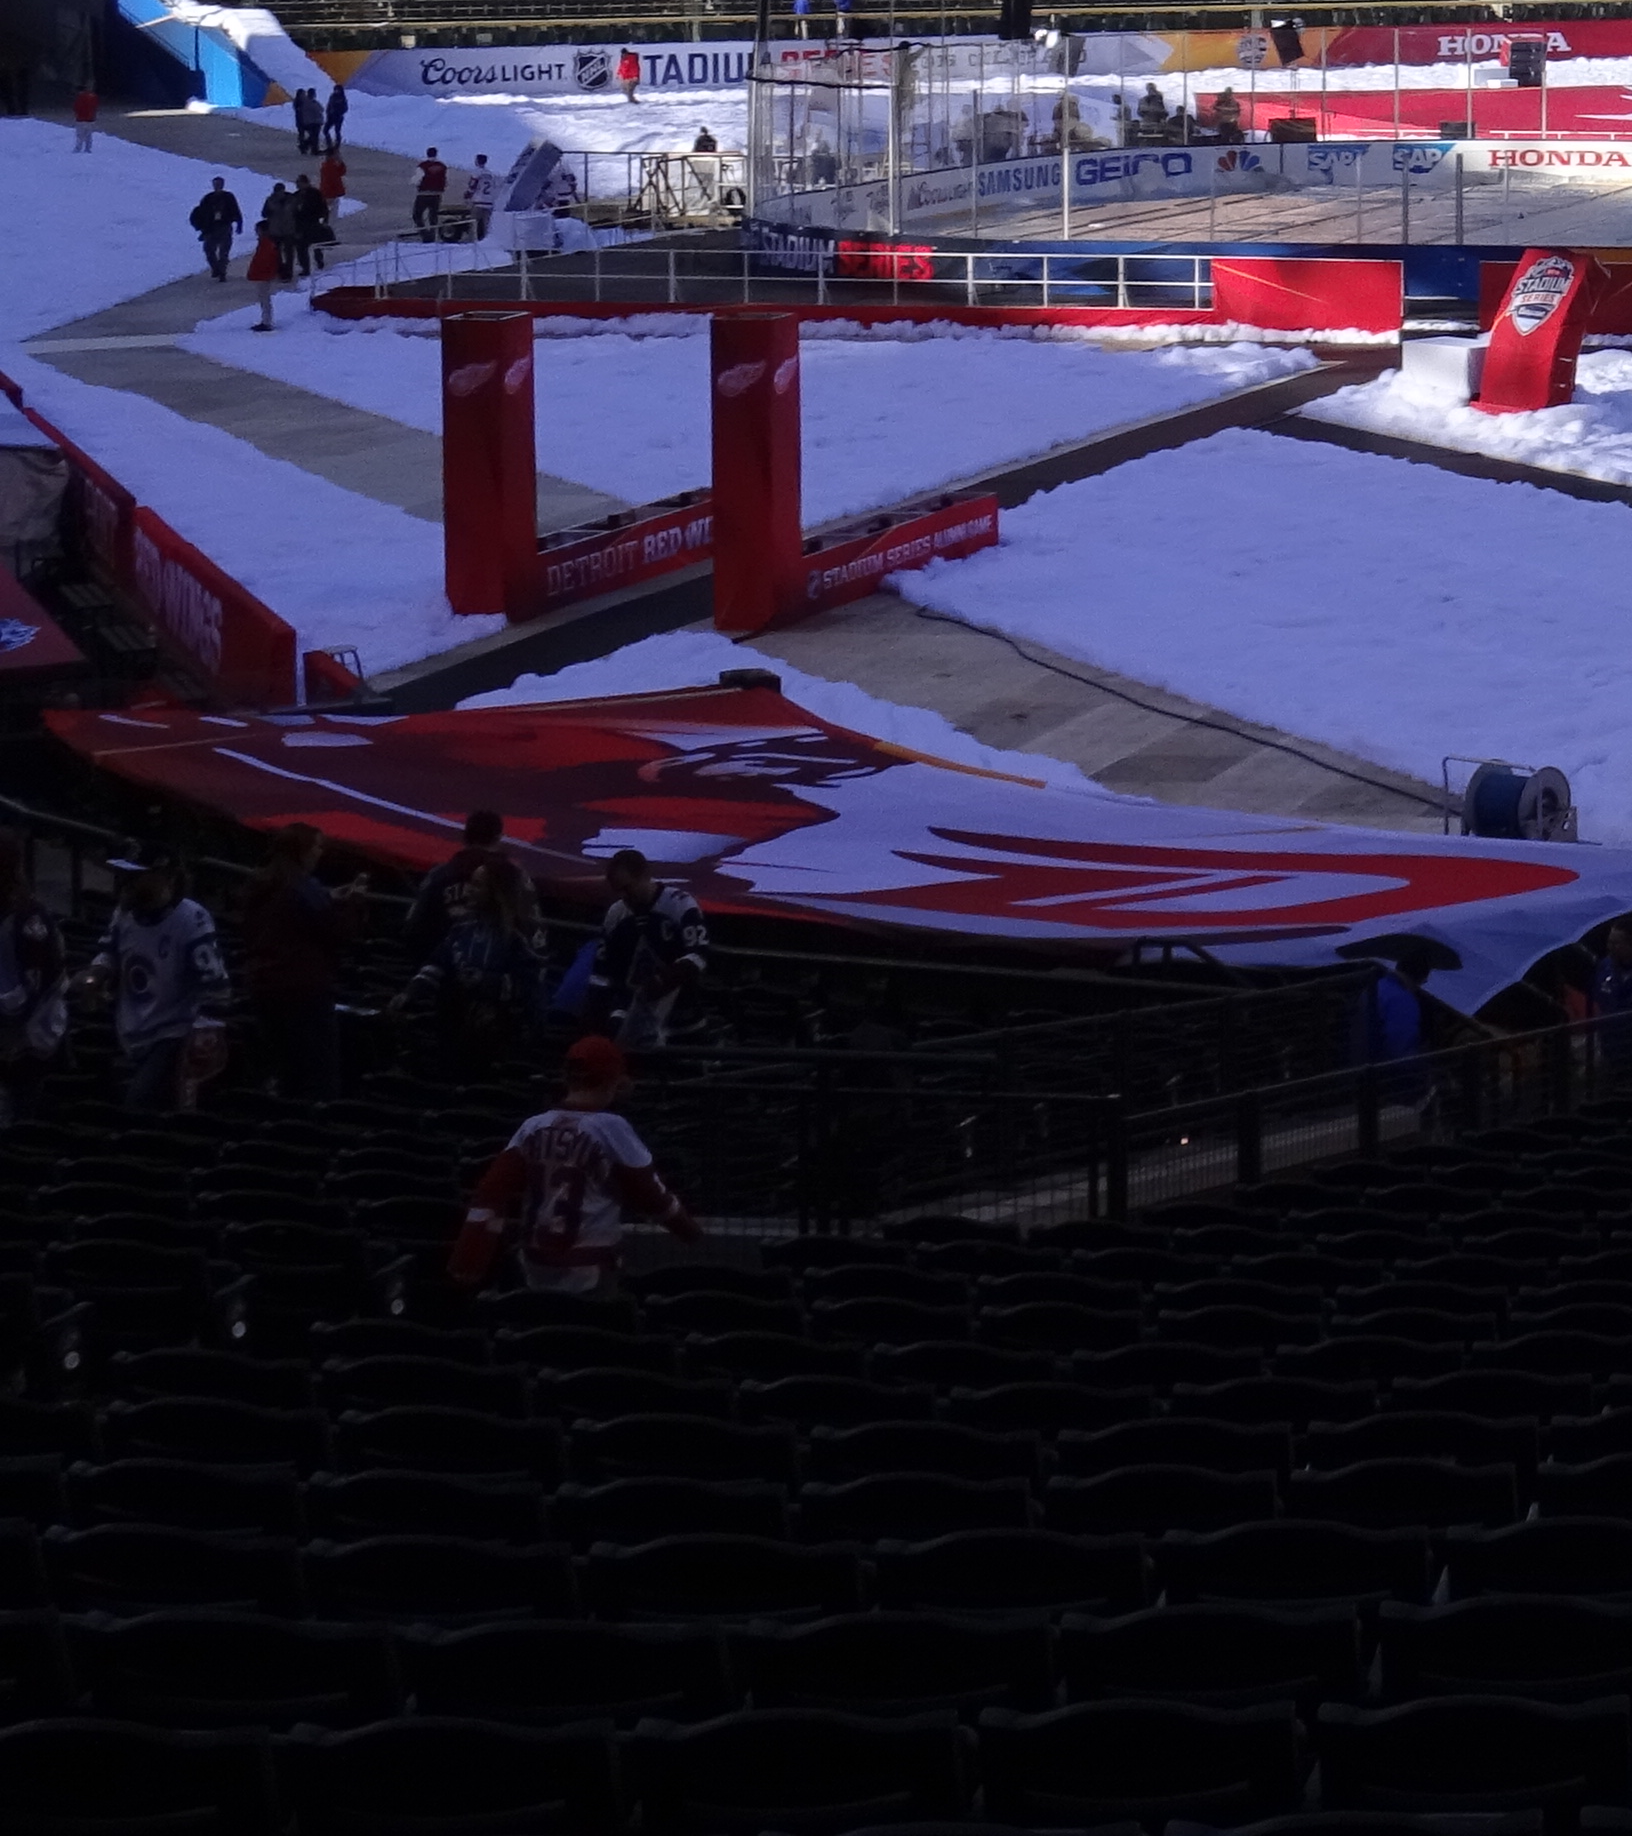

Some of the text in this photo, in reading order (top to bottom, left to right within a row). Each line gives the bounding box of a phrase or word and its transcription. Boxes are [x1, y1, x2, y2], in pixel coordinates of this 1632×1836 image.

[420, 57, 565, 86] Coors LIGHT
[1075, 152, 1194, 185] GEICO
[1394, 145, 1442, 167] SAP
[1488, 149, 1632, 168] HONDA
[978, 163, 1062, 196] SAMSUNG
[1516, 276, 1569, 294] STADIUM
[1521, 294, 1555, 303] SERIES
[547, 526, 681, 596] DETROIT RED
[823, 551, 884, 590] STADIUM
[886, 535, 932, 566] SERIES
[934, 525, 966, 551] ALUMNI
[683, 924, 710, 947] 92
